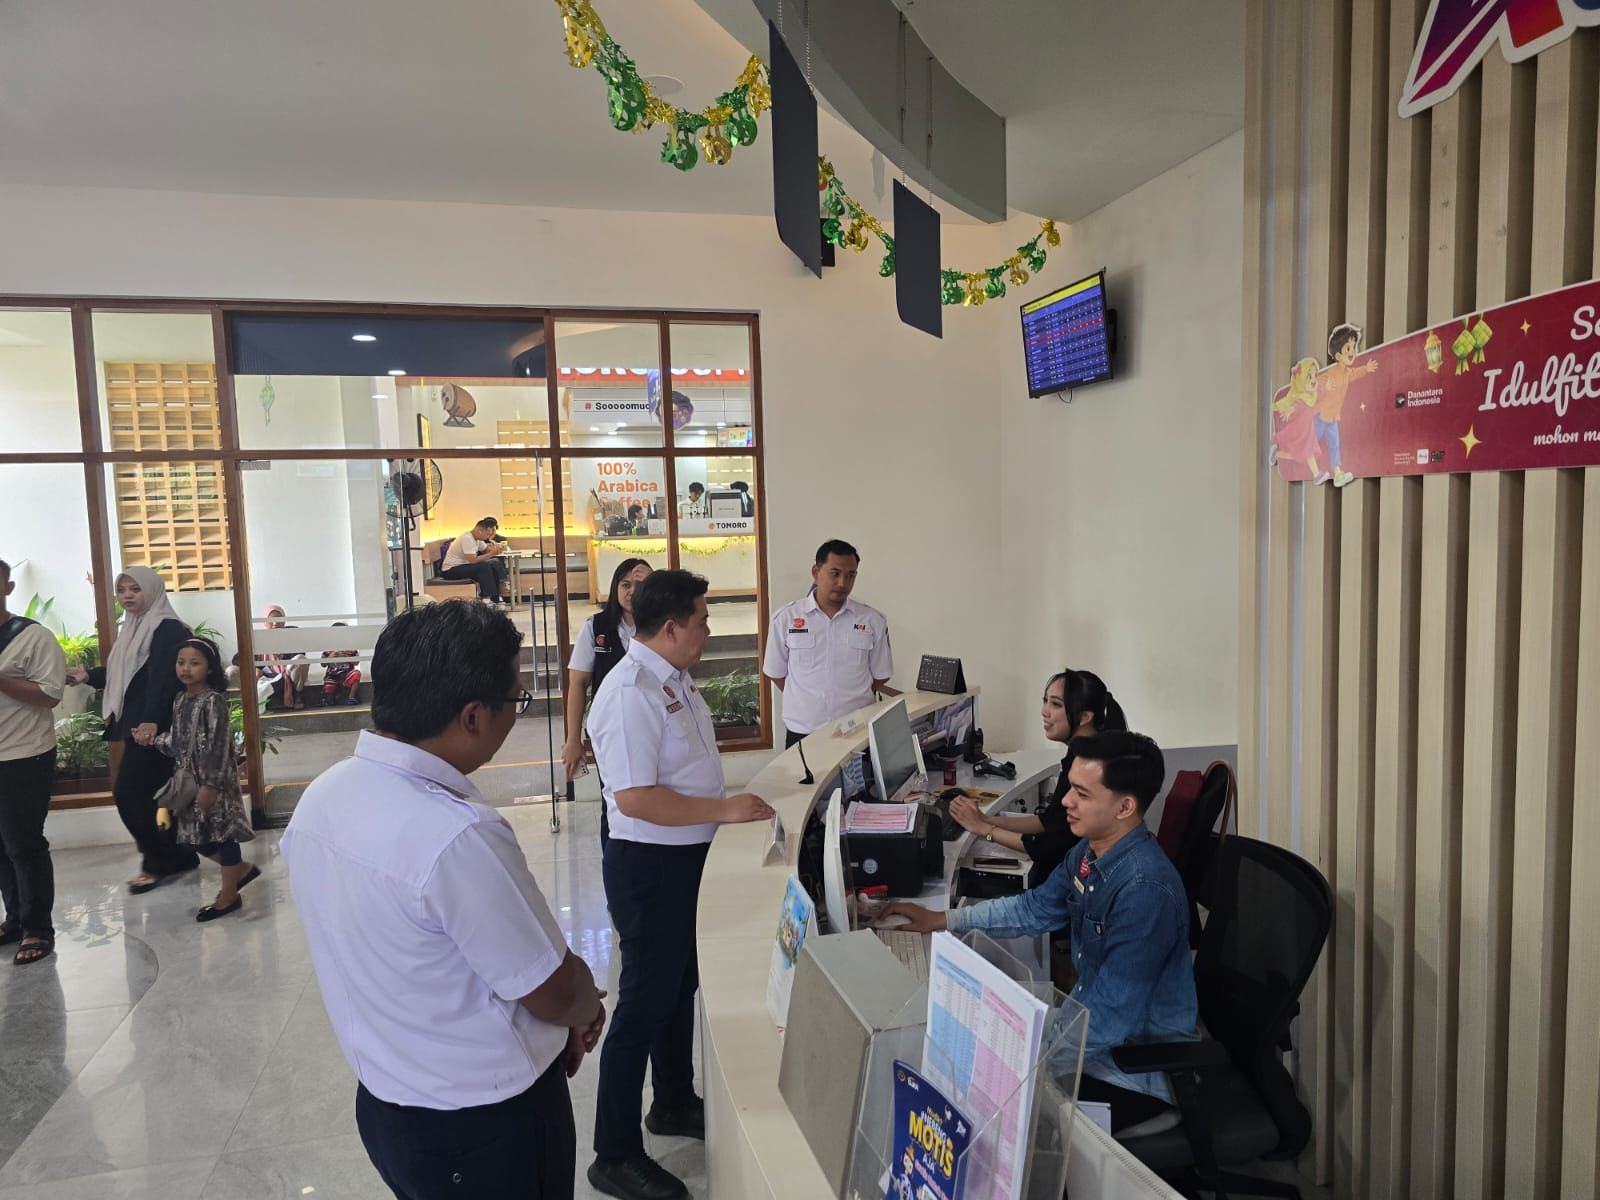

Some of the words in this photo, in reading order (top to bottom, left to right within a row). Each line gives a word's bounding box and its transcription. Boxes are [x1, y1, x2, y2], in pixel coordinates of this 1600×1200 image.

[1407, 388, 1443, 400] Danantara
[1407, 396, 1441, 408] Indonesia
[1533, 425, 1578, 446] mohon
[597, 462, 637, 475] 100%
[598, 479, 658, 492] Arabica
[909, 1110, 954, 1178] MOTIS
